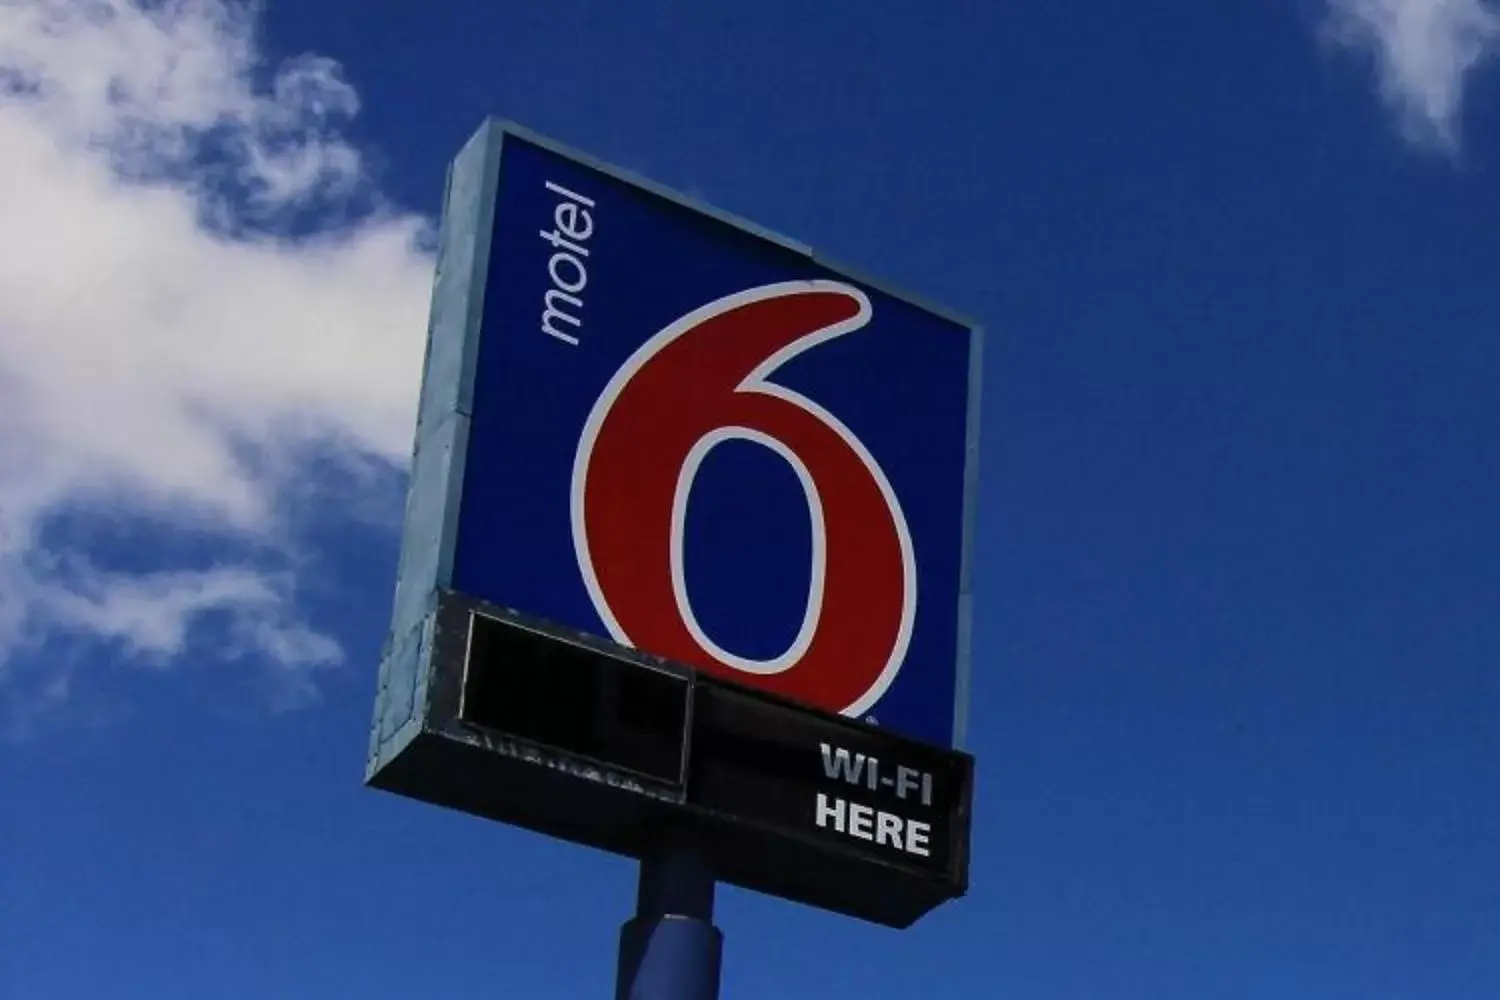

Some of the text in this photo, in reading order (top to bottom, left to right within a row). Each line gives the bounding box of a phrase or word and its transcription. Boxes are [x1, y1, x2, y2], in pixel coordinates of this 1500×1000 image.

[541, 182, 596, 346] motel
[570, 279, 917, 719] 6
[815, 794, 933, 858] HERE
[819, 743, 934, 807] WI-FI
